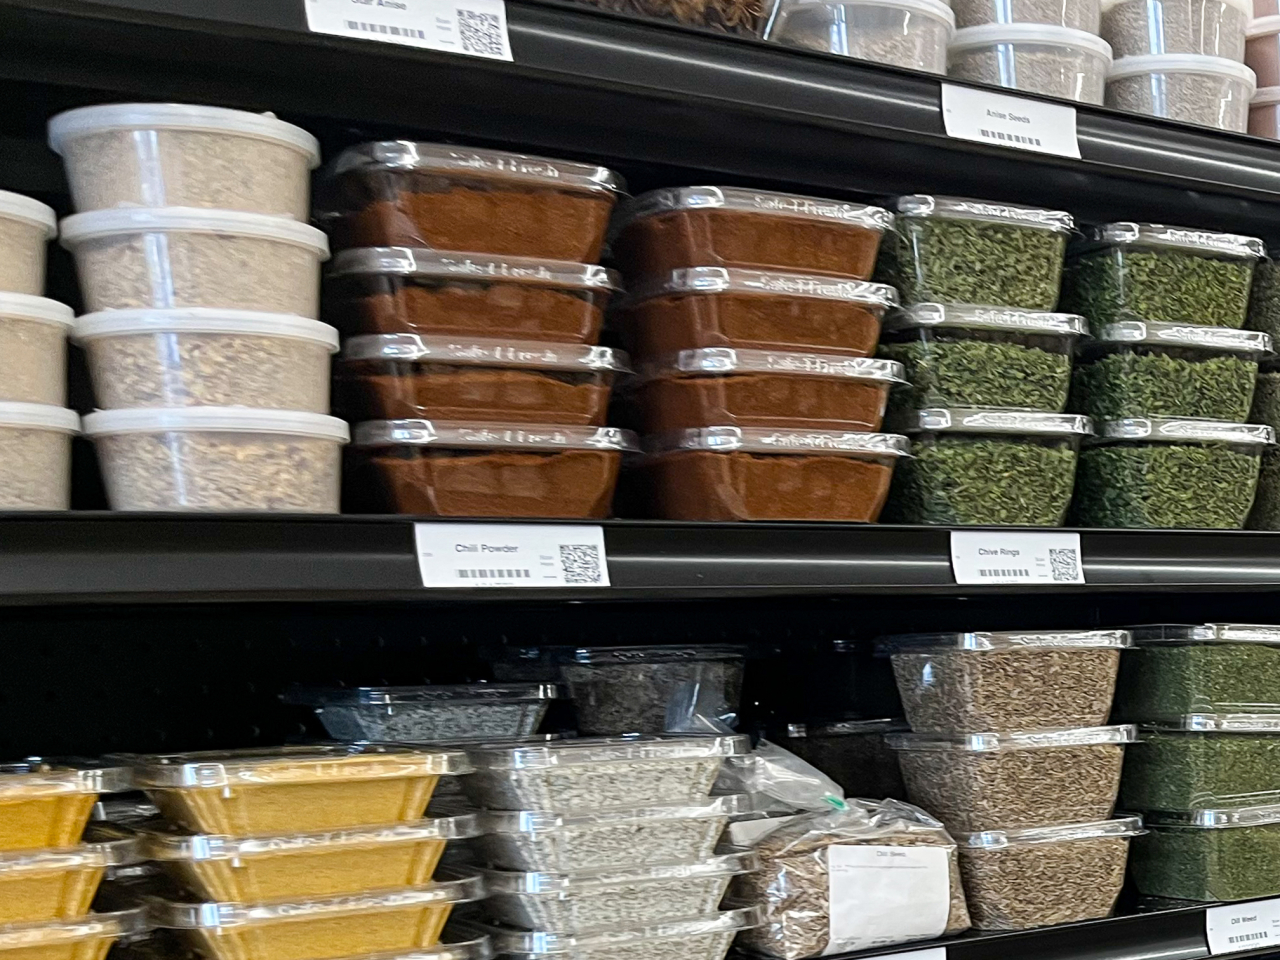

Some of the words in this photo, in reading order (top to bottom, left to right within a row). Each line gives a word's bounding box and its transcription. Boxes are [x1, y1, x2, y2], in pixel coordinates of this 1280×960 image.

[986, 109, 1007, 119] Anise
[1008, 112, 1030, 124] Seeds
[455, 544, 479, 553] Chili
[481, 544, 519, 553] Powder
[978, 548, 998, 556] Chive
[1000, 548, 1020, 558] Rings
[1231, 917, 1241, 925] Dill
[1242, 915, 1257, 924] Weed
